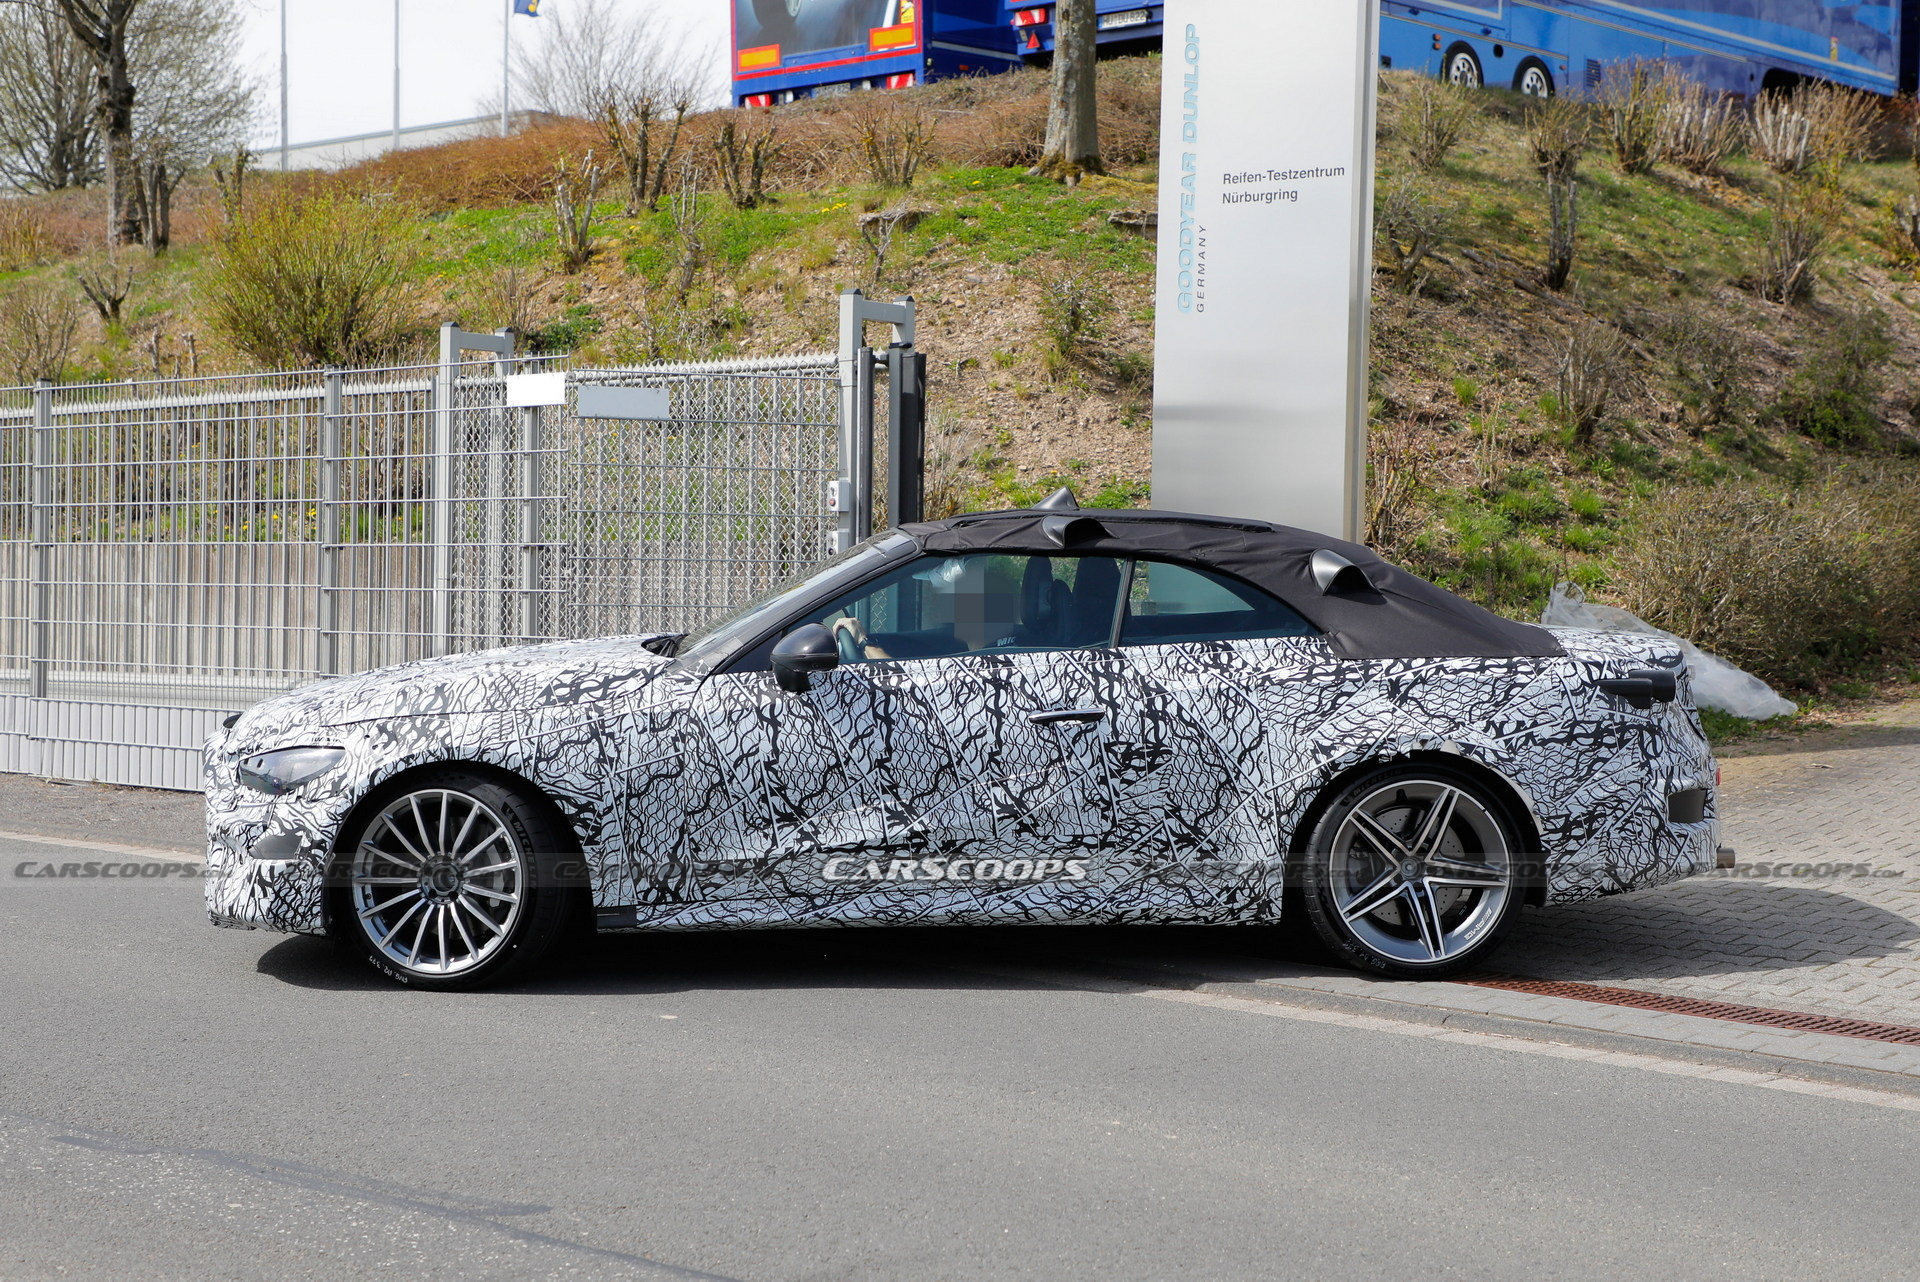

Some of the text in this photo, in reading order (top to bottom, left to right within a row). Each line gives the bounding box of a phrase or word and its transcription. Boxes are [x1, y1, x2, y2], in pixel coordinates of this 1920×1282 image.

[1178, 23, 1201, 314] GOODYEAR DUNLOP
[1222, 166, 1345, 185] Reifen-Testzentrum
[1222, 188, 1298, 204] Nürburgring
[1196, 225, 1208, 313] GERMANY
[513, 821, 538, 890] MICHELIN
